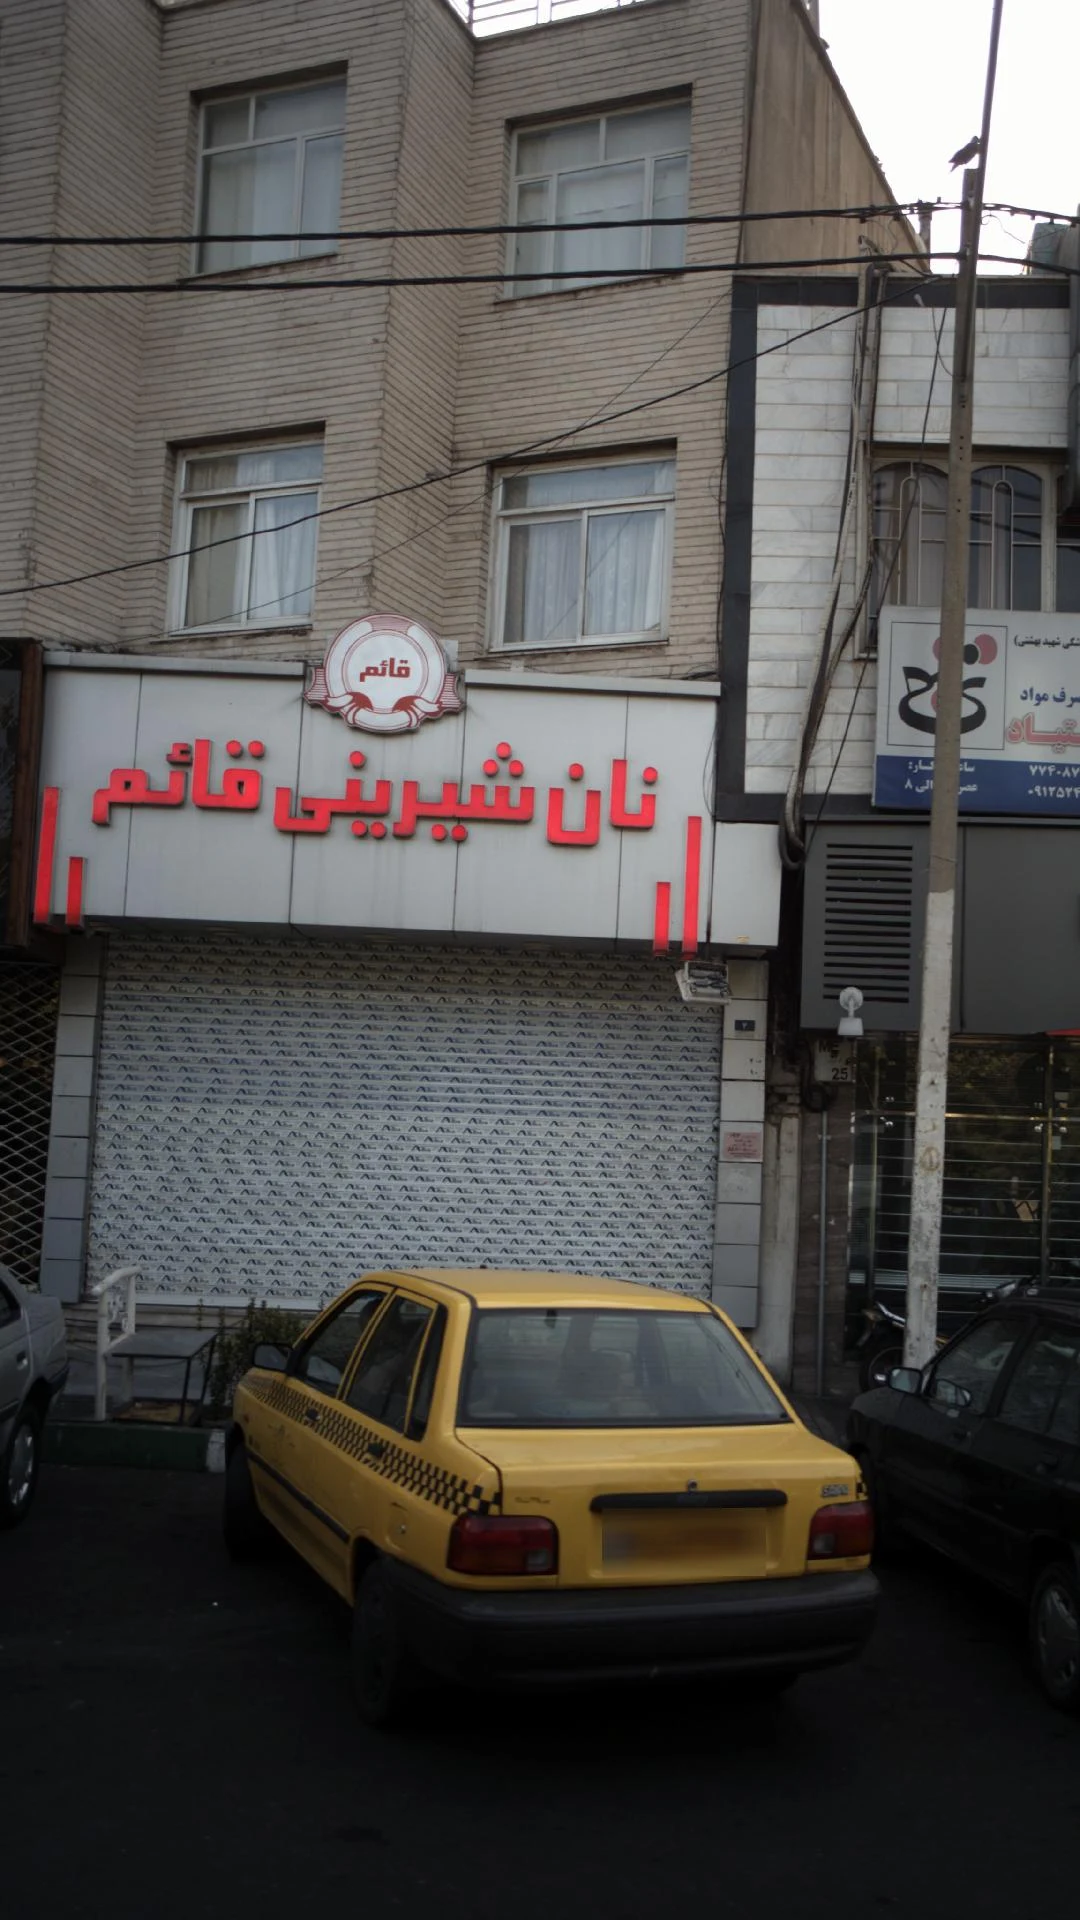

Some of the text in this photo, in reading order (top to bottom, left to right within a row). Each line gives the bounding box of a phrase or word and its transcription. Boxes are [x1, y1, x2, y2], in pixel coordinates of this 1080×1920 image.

[359, 656, 411, 683] قائم
[1020, 686, 1049, 707] مواد
[1006, 712, 1080, 754] تیاد
[1029, 764, 1080, 778] ۷۷۴۰۸۷
[92, 738, 658, 846] نان شیرینی قائم
[832, 1067, 848, 1081] 25
